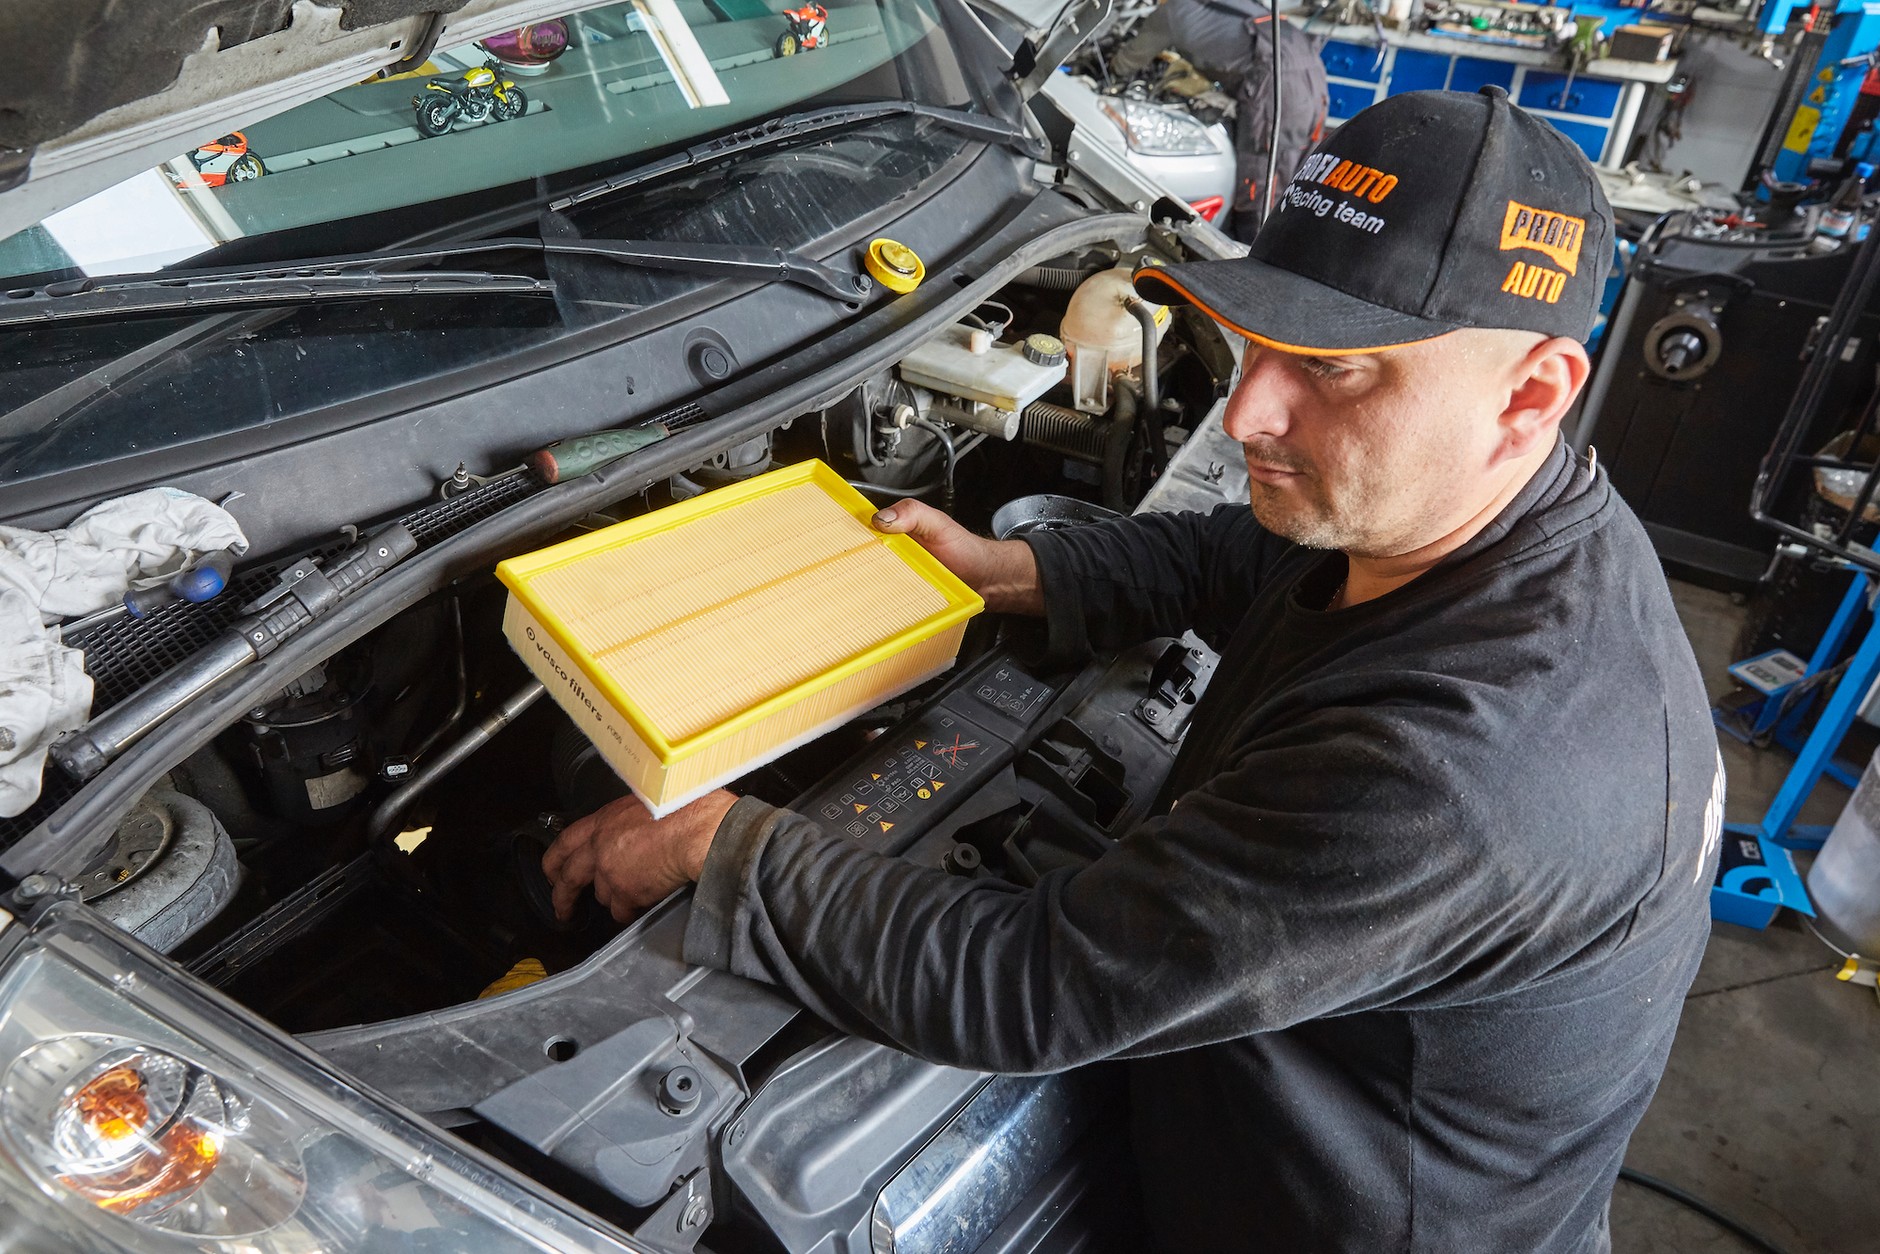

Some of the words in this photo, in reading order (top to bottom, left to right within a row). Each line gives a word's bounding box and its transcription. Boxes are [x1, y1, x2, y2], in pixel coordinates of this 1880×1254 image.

[1333, 200, 1385, 234] team
[1510, 208, 1580, 252] PROFI
[1501, 260, 1567, 304] AUTO
[536, 642, 568, 681] vasco
[569, 678, 603, 722] filters
